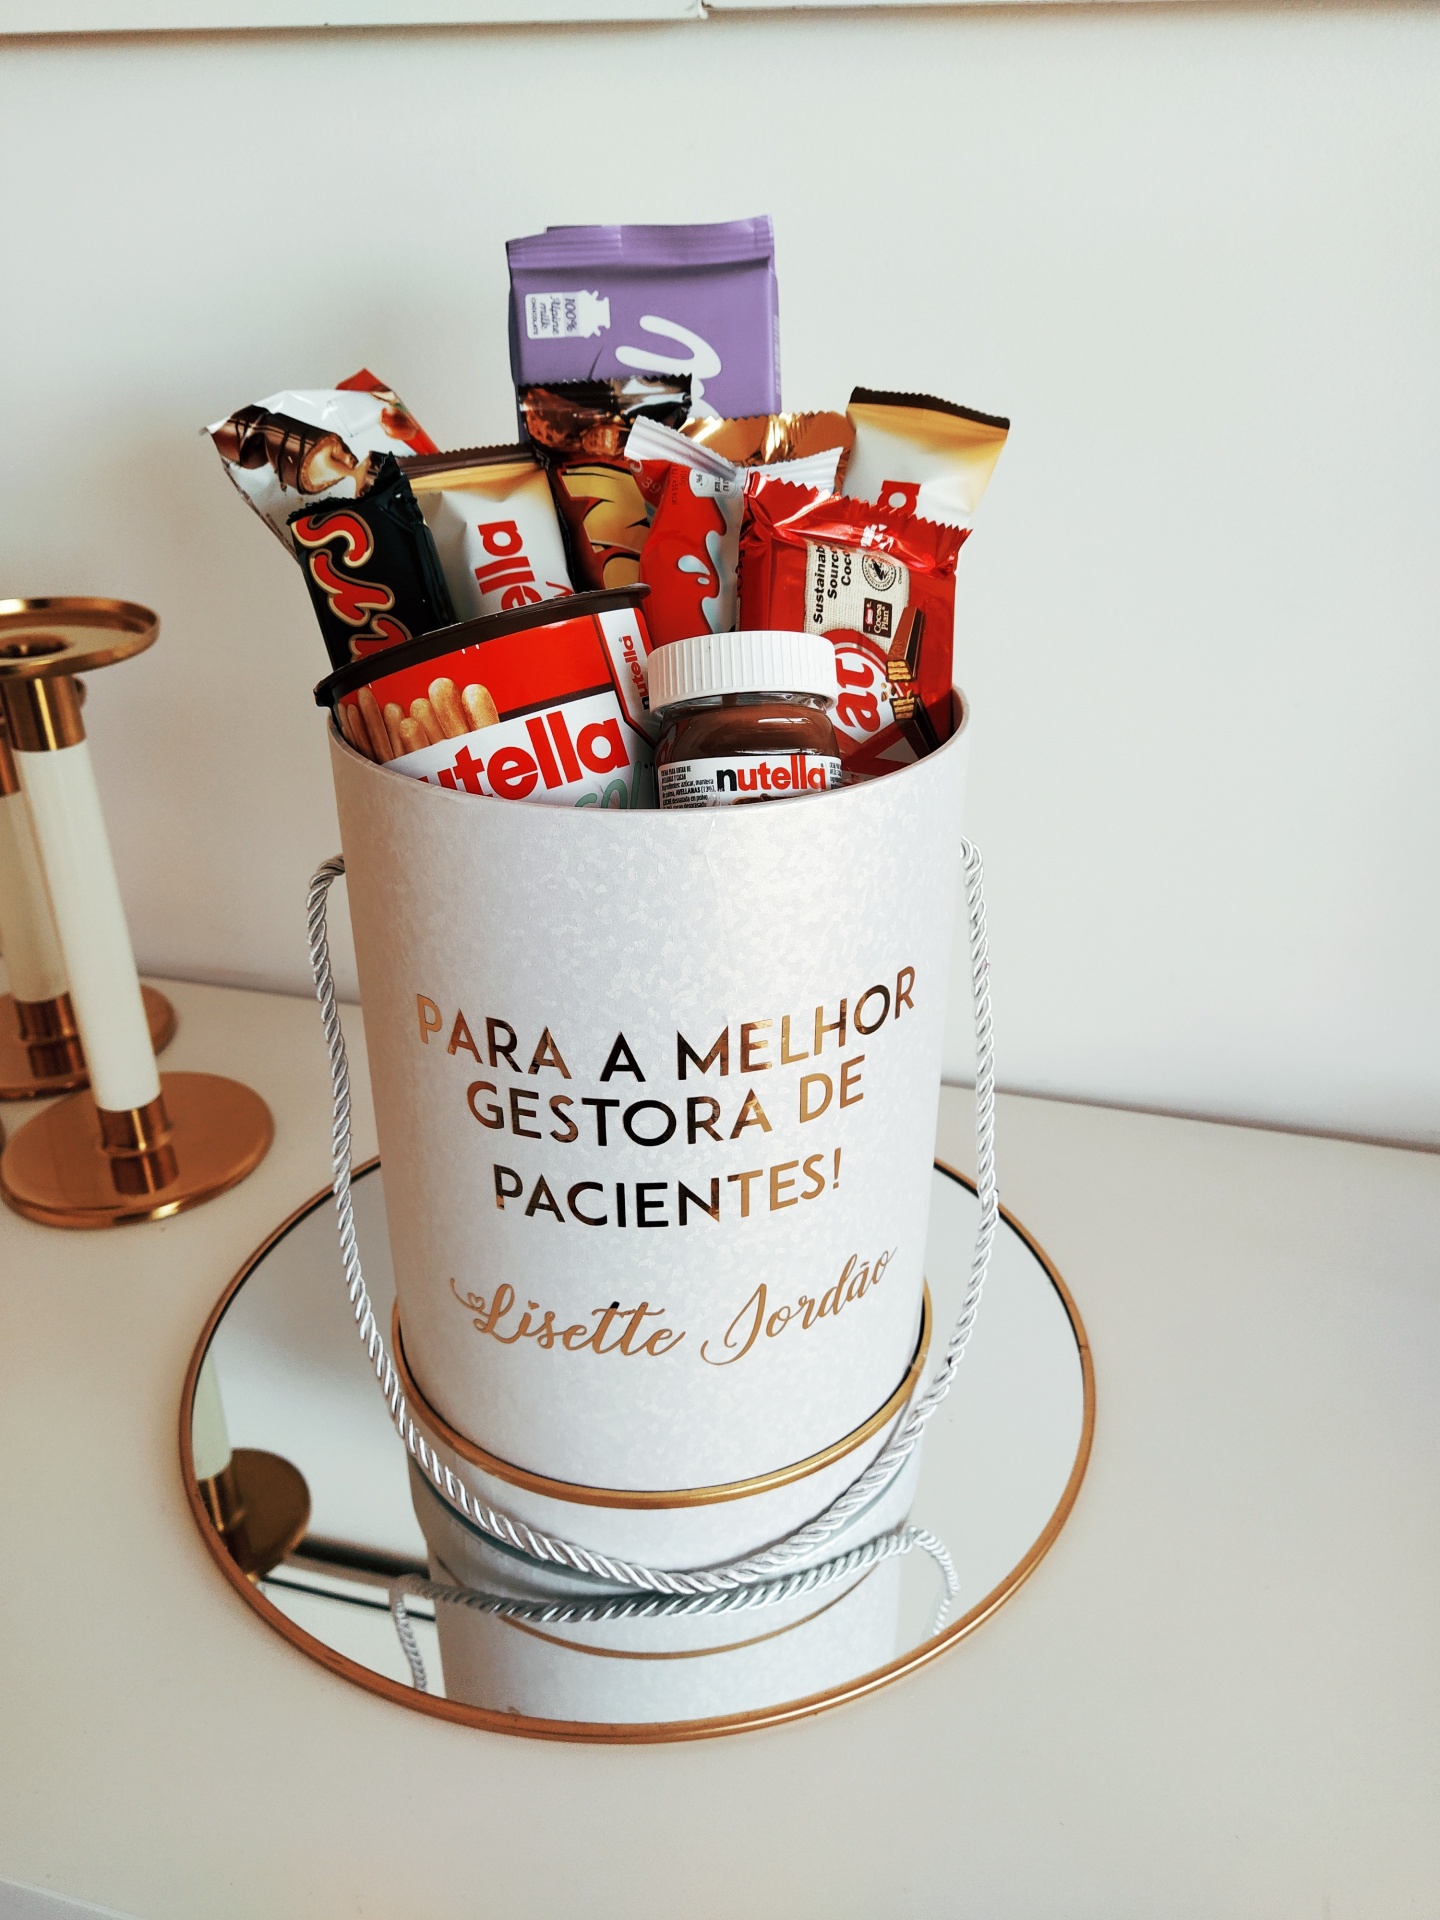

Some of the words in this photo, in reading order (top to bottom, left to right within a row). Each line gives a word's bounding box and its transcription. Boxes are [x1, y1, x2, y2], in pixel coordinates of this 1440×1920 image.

[565, 298, 577, 332] 100%
[874, 603, 882, 633] Cocoa
[716, 755, 827, 791] nutella
[416, 993, 572, 1080] PARA
[600, 1031, 646, 1082] A
[677, 966, 916, 1081] MELHOR
[466, 1081, 773, 1147] GESTORA
[799, 1054, 866, 1124] DE
[493, 1147, 843, 1229] PACIENTES!
[449, 1278, 687, 1357] Lisette
[700, 1246, 898, 1366] Jordão
